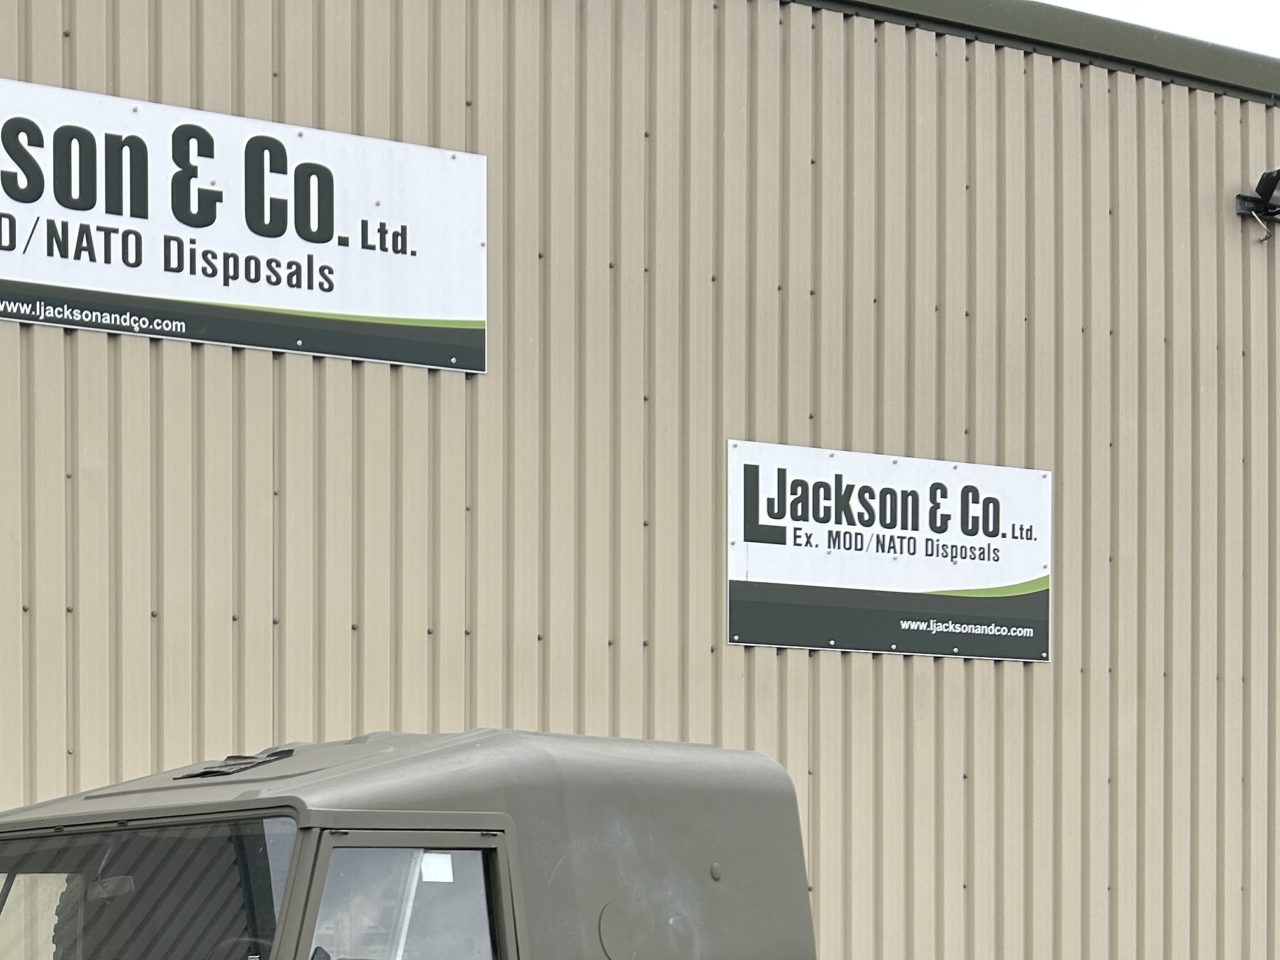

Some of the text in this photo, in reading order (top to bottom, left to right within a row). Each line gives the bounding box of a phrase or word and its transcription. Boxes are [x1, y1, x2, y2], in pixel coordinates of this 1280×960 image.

[170, 123, 224, 229] &
[244, 135, 350, 248] Co.
[360, 219, 417, 257] Ltd.
[163, 234, 335, 293] Disposals
[928, 482, 952, 535] &
[960, 484, 1007, 539] Co.
[1011, 523, 1038, 542] Ltd.
[793, 526, 1000, 563] Ex. MOD/NATO Disposals
[899, 619, 1034, 638] www.ljacksonandco.com
